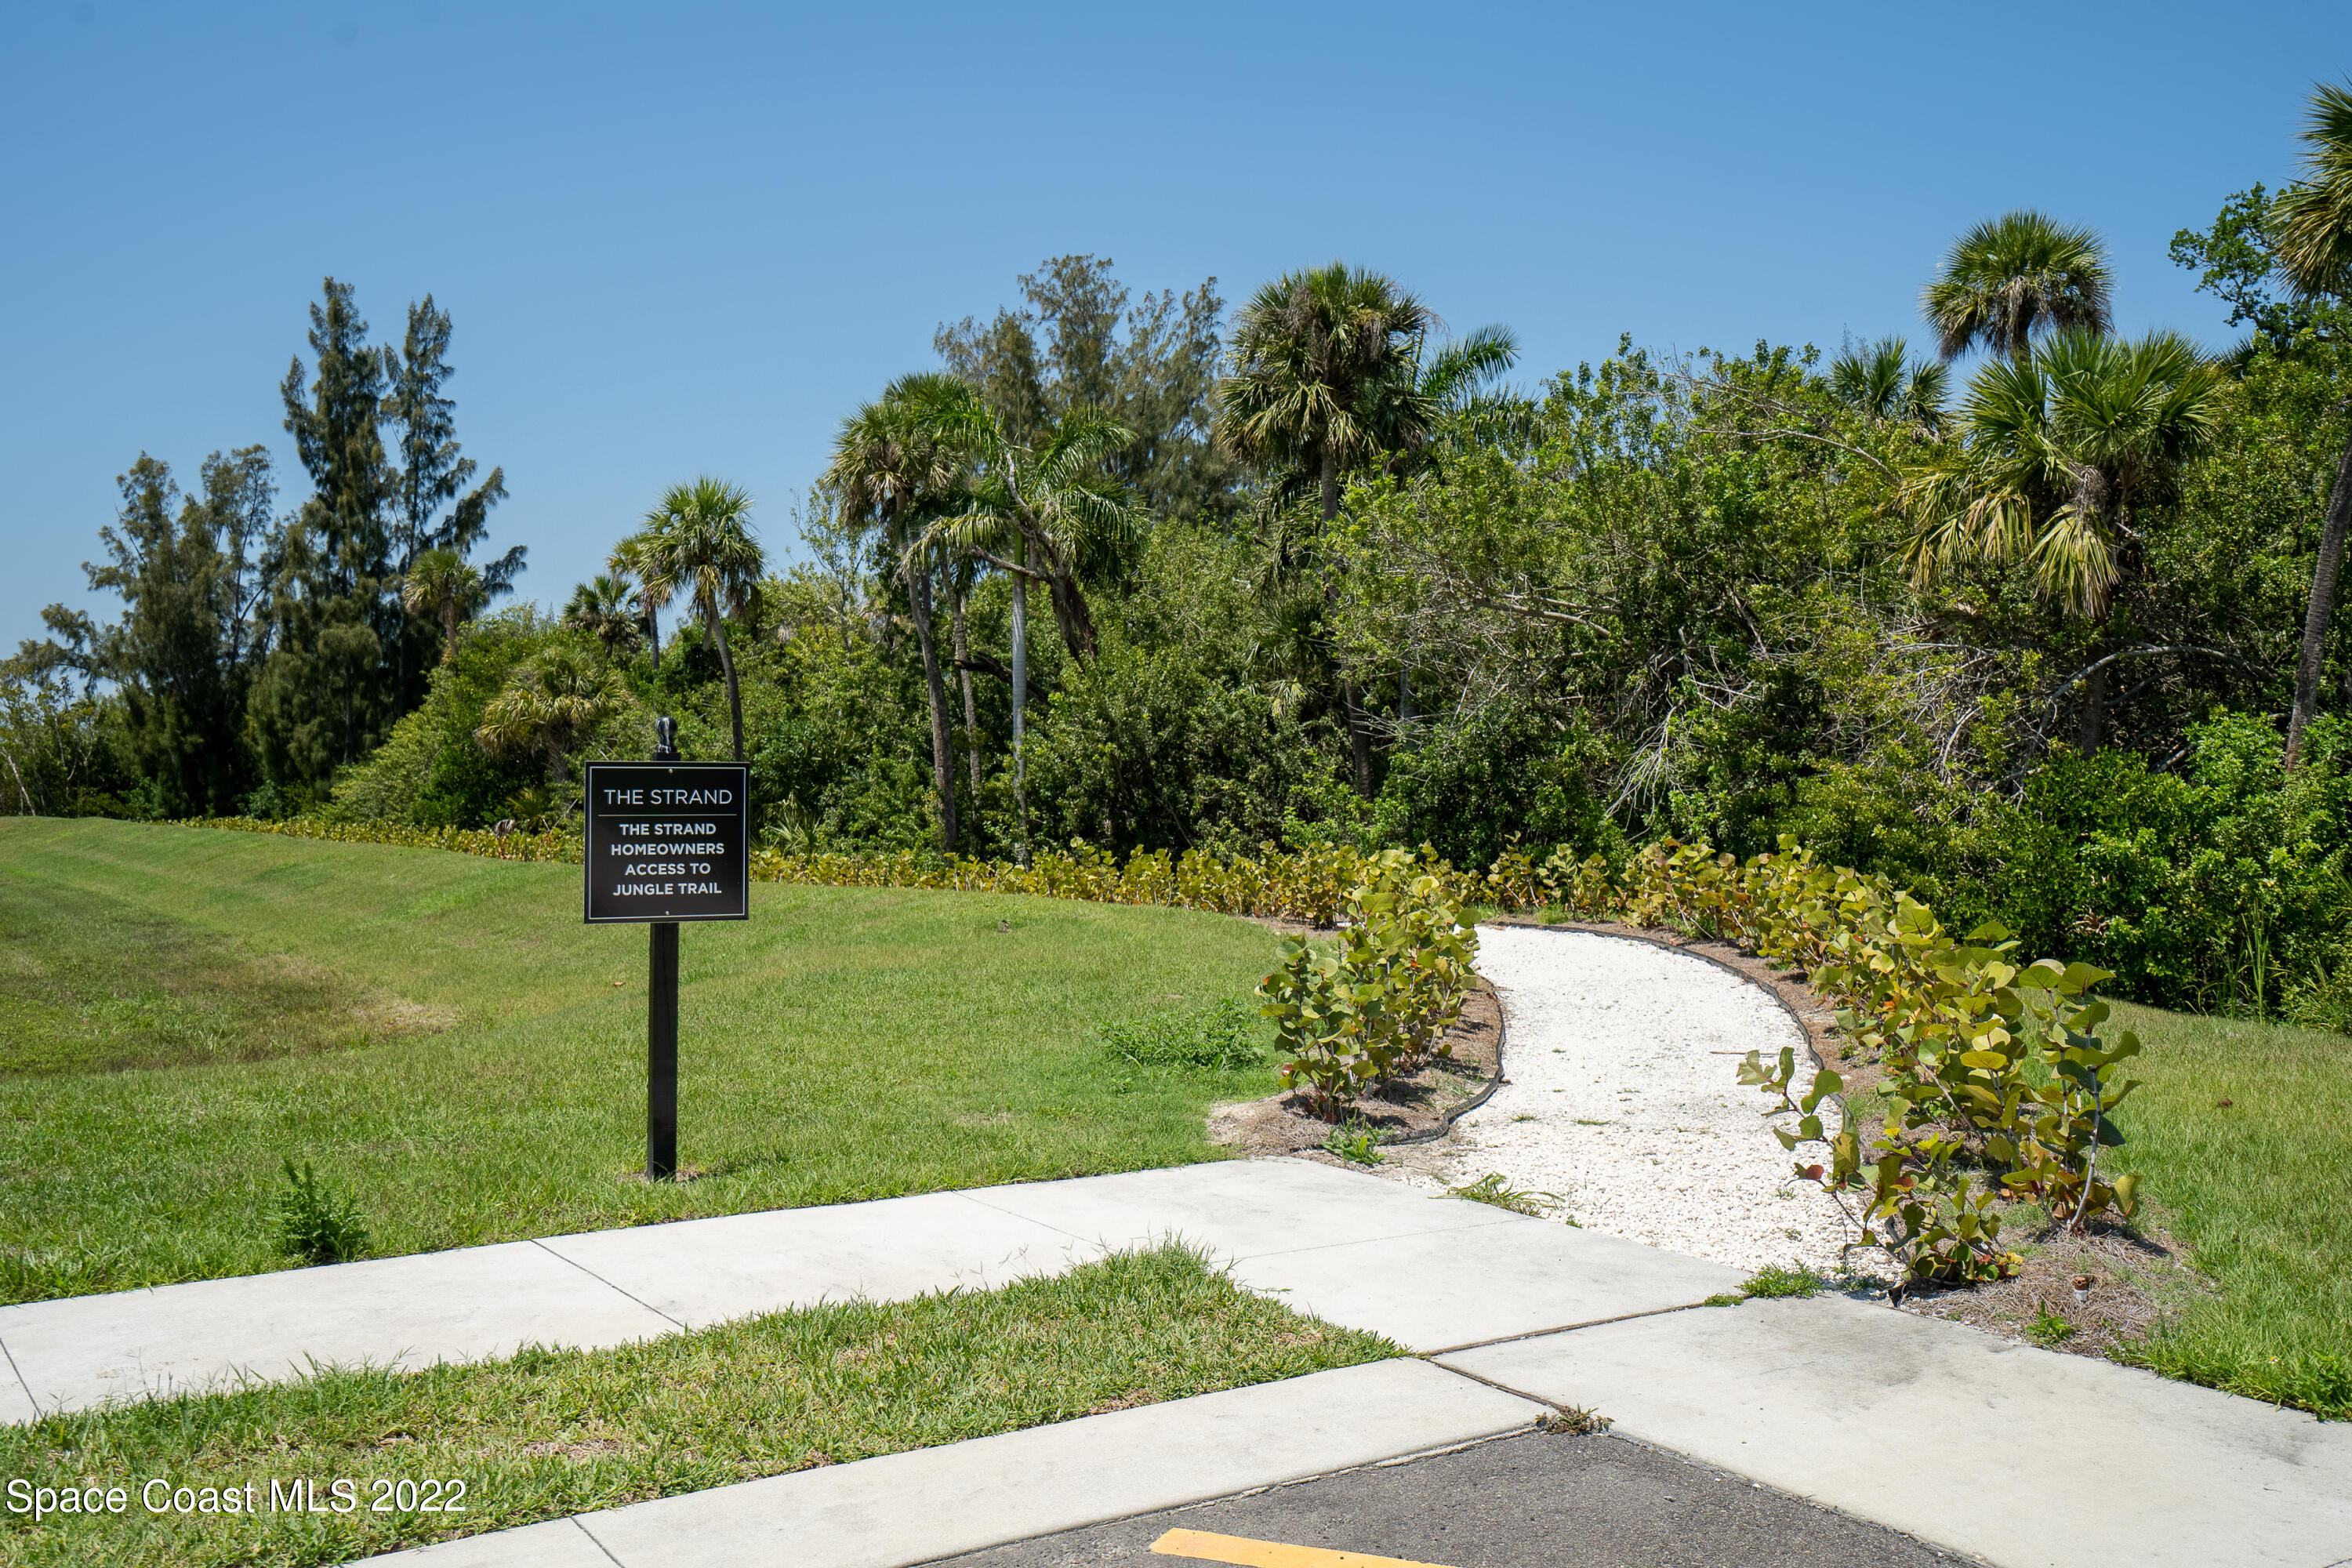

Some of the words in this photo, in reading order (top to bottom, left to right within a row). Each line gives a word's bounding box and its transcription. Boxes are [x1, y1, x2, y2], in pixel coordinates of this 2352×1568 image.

[604, 789, 644, 804] THE
[650, 789, 732, 804] STRAND
[619, 823, 650, 836] THE
[654, 823, 717, 835] STRAND
[611, 843, 724, 856] HOMEOWNERS
[624, 863, 686, 876] ACCESS
[689, 862, 711, 875] TO
[612, 883, 674, 896] JUNGLE
[677, 882, 722, 895] TRAIL
